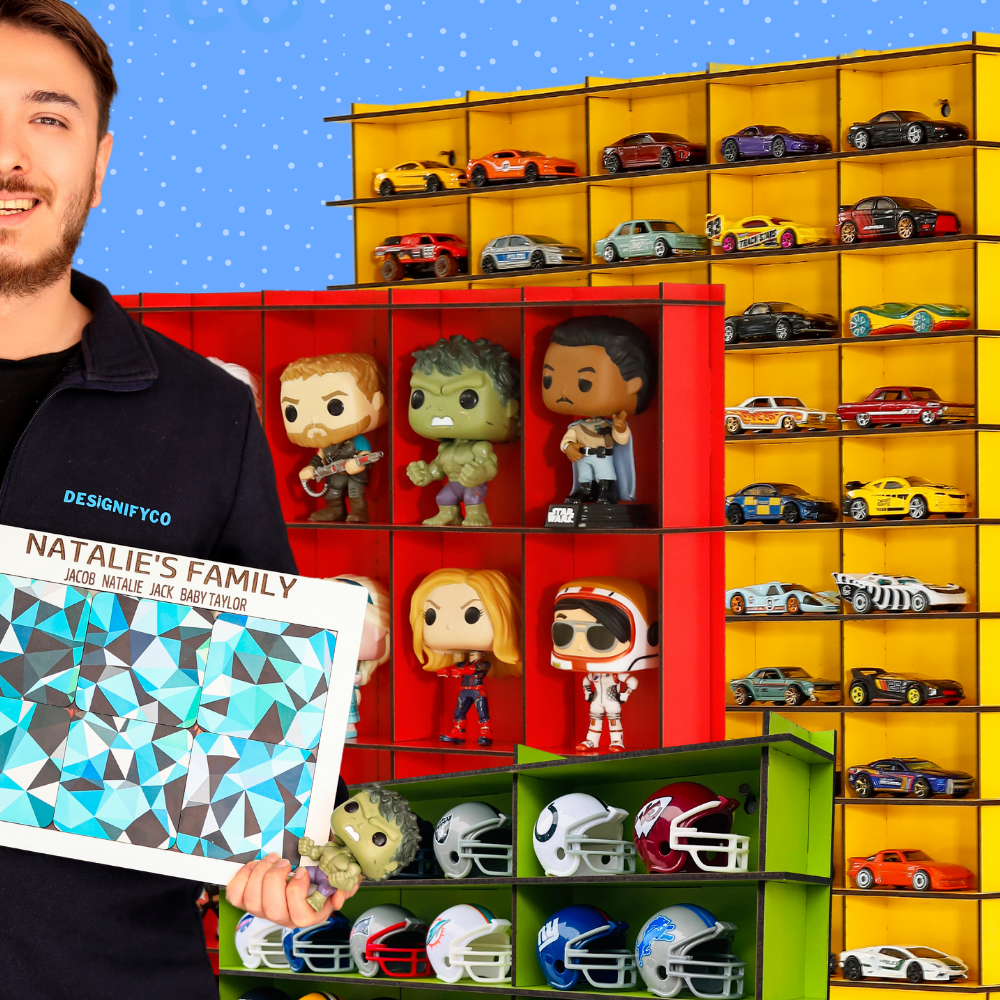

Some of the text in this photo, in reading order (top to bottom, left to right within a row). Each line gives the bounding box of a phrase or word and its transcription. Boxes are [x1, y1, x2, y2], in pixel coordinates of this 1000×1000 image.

[551, 507, 574, 516] STAR
[25, 532, 298, 599] NATALIE'S FAMILY
[63, 567, 248, 612] JACOB NATALIE JACK BABY TAYLOR
